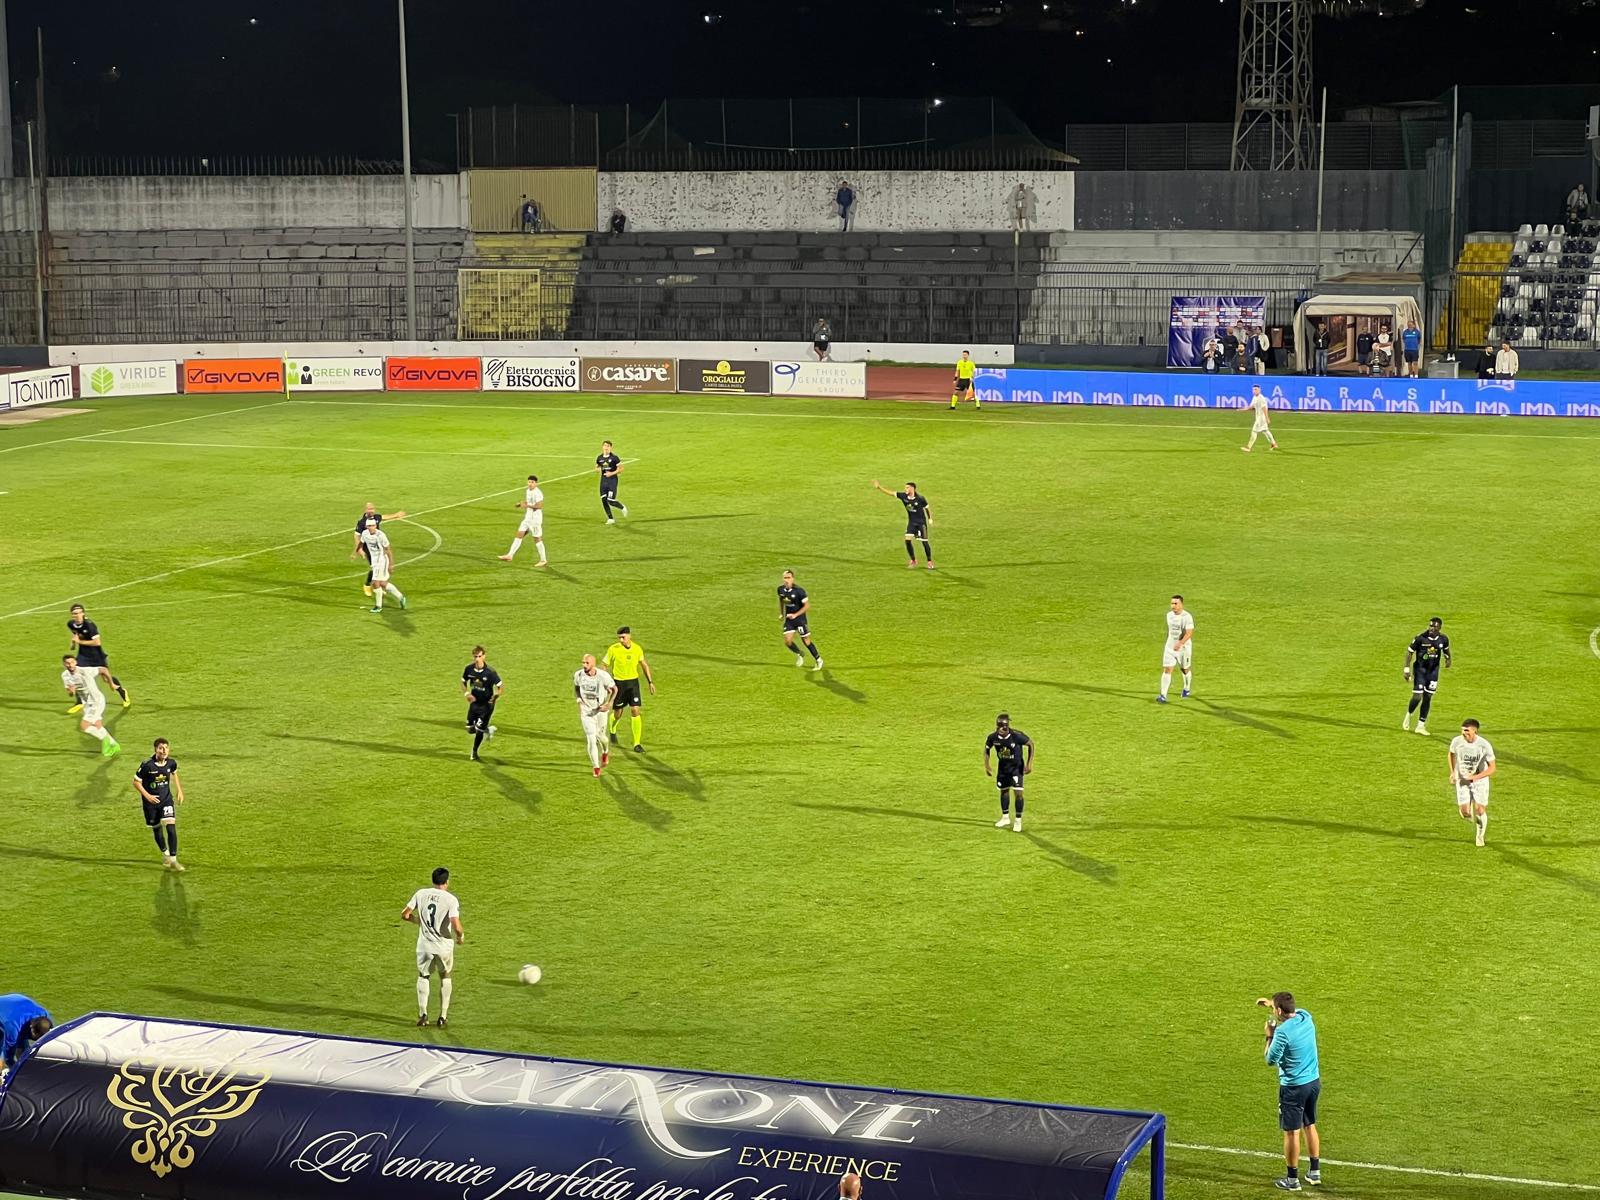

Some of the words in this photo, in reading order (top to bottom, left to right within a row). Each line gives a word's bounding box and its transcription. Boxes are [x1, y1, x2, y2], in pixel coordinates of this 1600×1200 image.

[120, 367, 166, 379] VIRIDE
[312, 368, 350, 377] GREEN
[353, 368, 382, 377] REVO
[406, 370, 478, 380] GIVOVA
[506, 366, 576, 375] Elettrotecnica
[816, 368, 847, 376] THIRD
[204, 373, 280, 383] GIVOVA
[506, 375, 576, 387] BISOGNO
[702, 376, 745, 384] OROGIALLO
[798, 376, 864, 385] GENERATION
[976, 389, 1003, 401] MD
[1265, 396, 1291, 409] MD
[427, 903, 437, 927] 3
[290, 1130, 388, 1183] La
[381, 1157, 497, 1187] cornice
[483, 1157, 637, 1200] perfetta
[634, 1180, 700, 1200] per
[737, 1146, 902, 1182] EXPERIENCE
